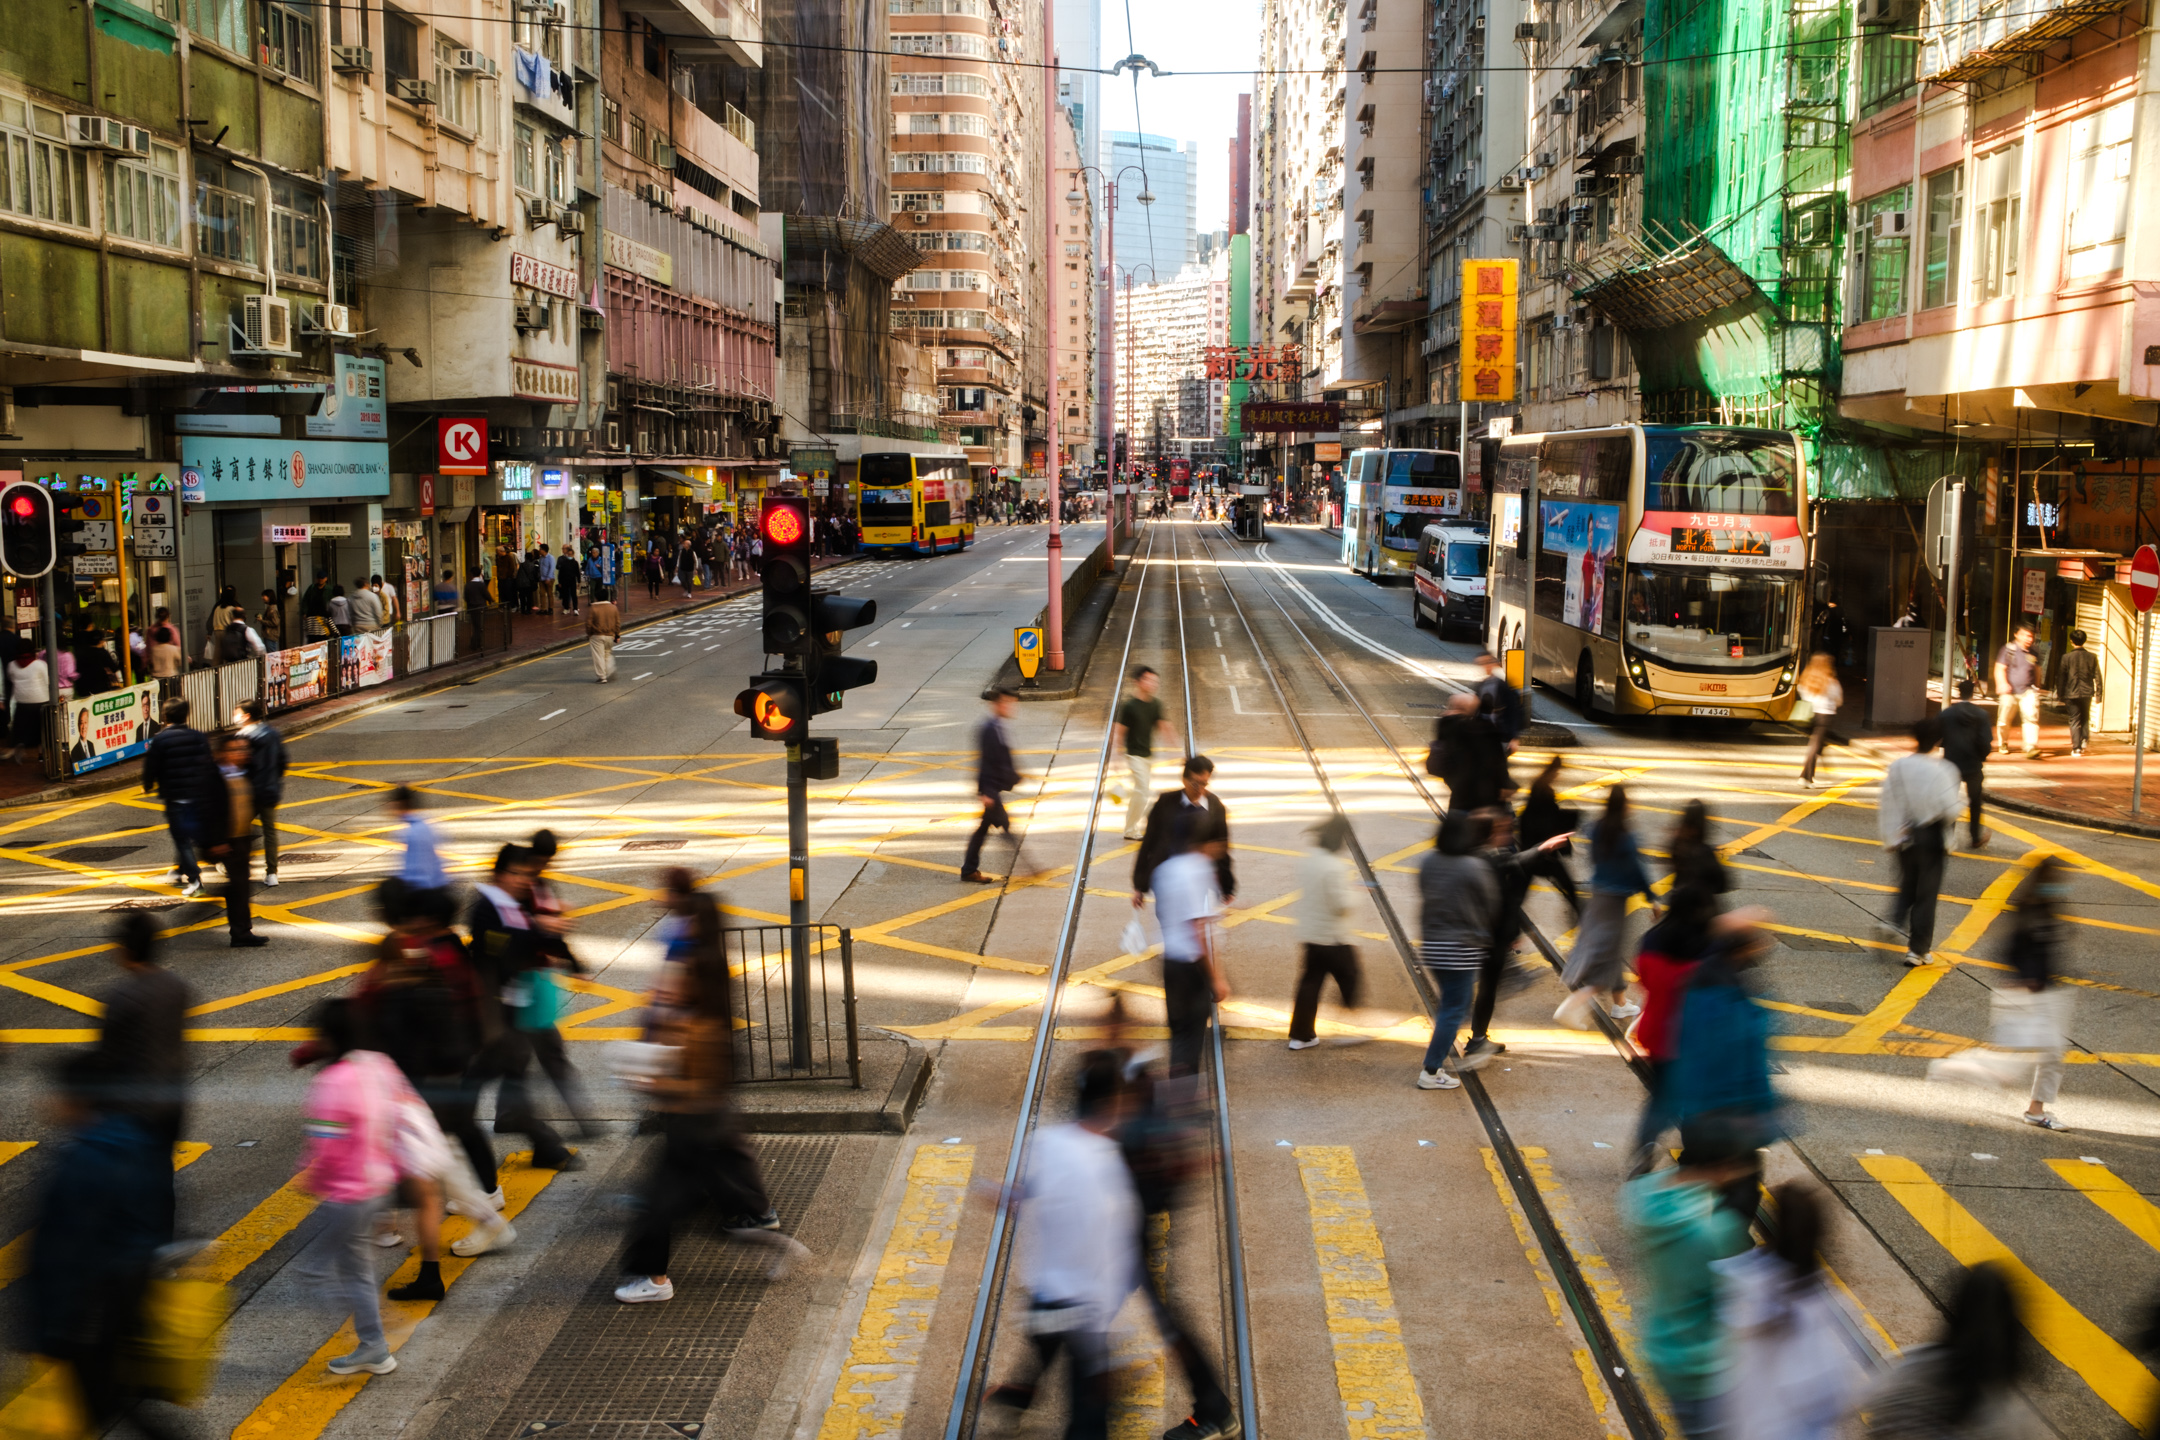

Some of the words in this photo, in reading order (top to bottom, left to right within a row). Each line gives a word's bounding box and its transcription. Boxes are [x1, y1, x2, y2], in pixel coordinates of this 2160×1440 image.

[197, 456, 288, 482] 海商業銀行
[307, 463, 334, 475] SHANGHAI
[334, 463, 366, 475] COMMERCIAL
[366, 463, 378, 474] BANK
[1690, 514, 1752, 529] 九巴月票
[99, 523, 106, 533] 7
[158, 530, 166, 539] 7
[1680, 528, 1717, 546] 北角
[100, 539, 107, 548] 7
[1727, 530, 1764, 554] 112
[160, 545, 173, 555] 12
[1707, 683, 1727, 692] KMB
[1708, 708, 1729, 716] 4342
